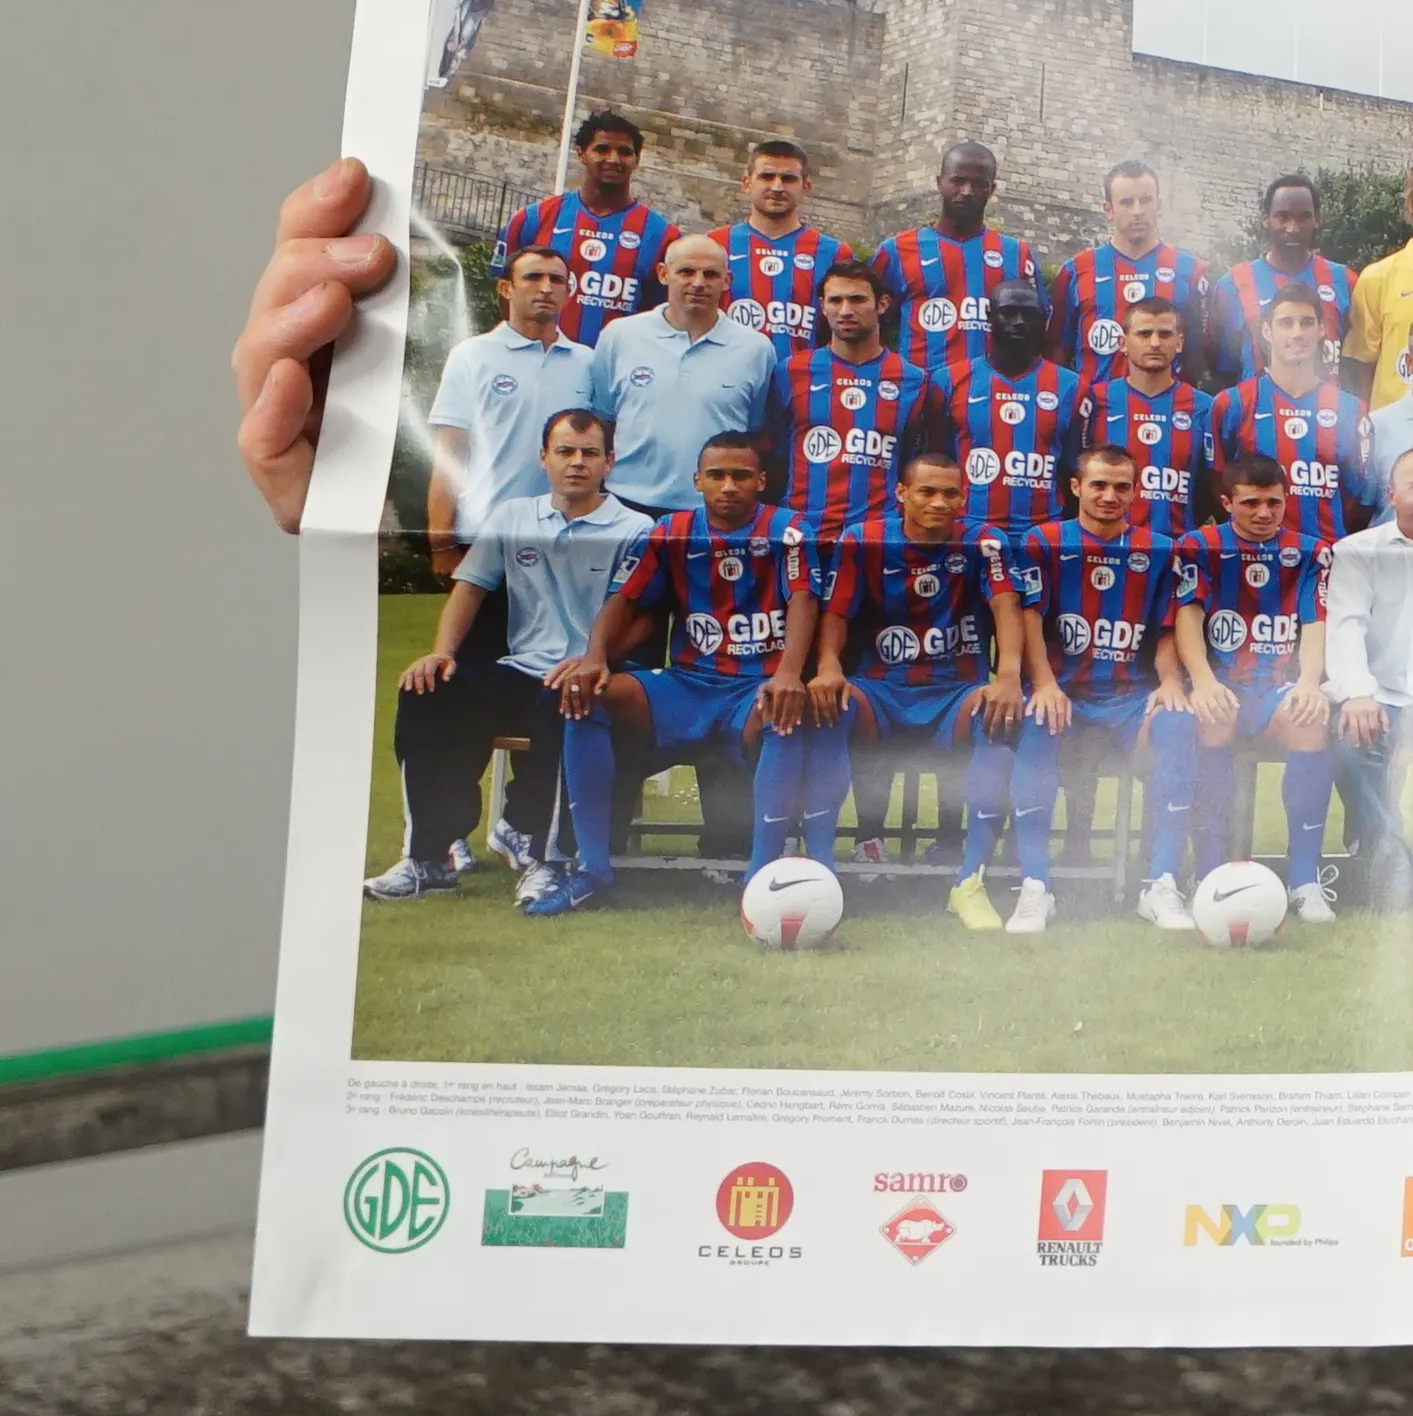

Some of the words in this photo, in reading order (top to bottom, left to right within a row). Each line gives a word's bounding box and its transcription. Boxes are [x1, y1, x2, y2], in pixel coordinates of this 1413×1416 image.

[580, 271, 638, 301] GDE
[767, 301, 816, 328] GDE
[845, 427, 897, 458] GDE
[1004, 450, 1056, 479] GDE
[1290, 460, 1339, 488] GDE
[1140, 465, 1192, 494] GDE
[727, 610, 786, 643] GDE
[924, 615, 980, 655] GDE
[1251, 613, 1298, 643] GDE
[509, 1147, 610, 1182] Campagne
[873, 1172, 967, 1192] samro
[354, 1157, 442, 1244] GDE
[1183, 1204, 1302, 1246] NXP
[698, 1244, 803, 1260] CELEOS
[1037, 1242, 1103, 1254] RENAULT
[1303, 1238, 1313, 1248] by
[1039, 1254, 1097, 1266] TRUCKS
